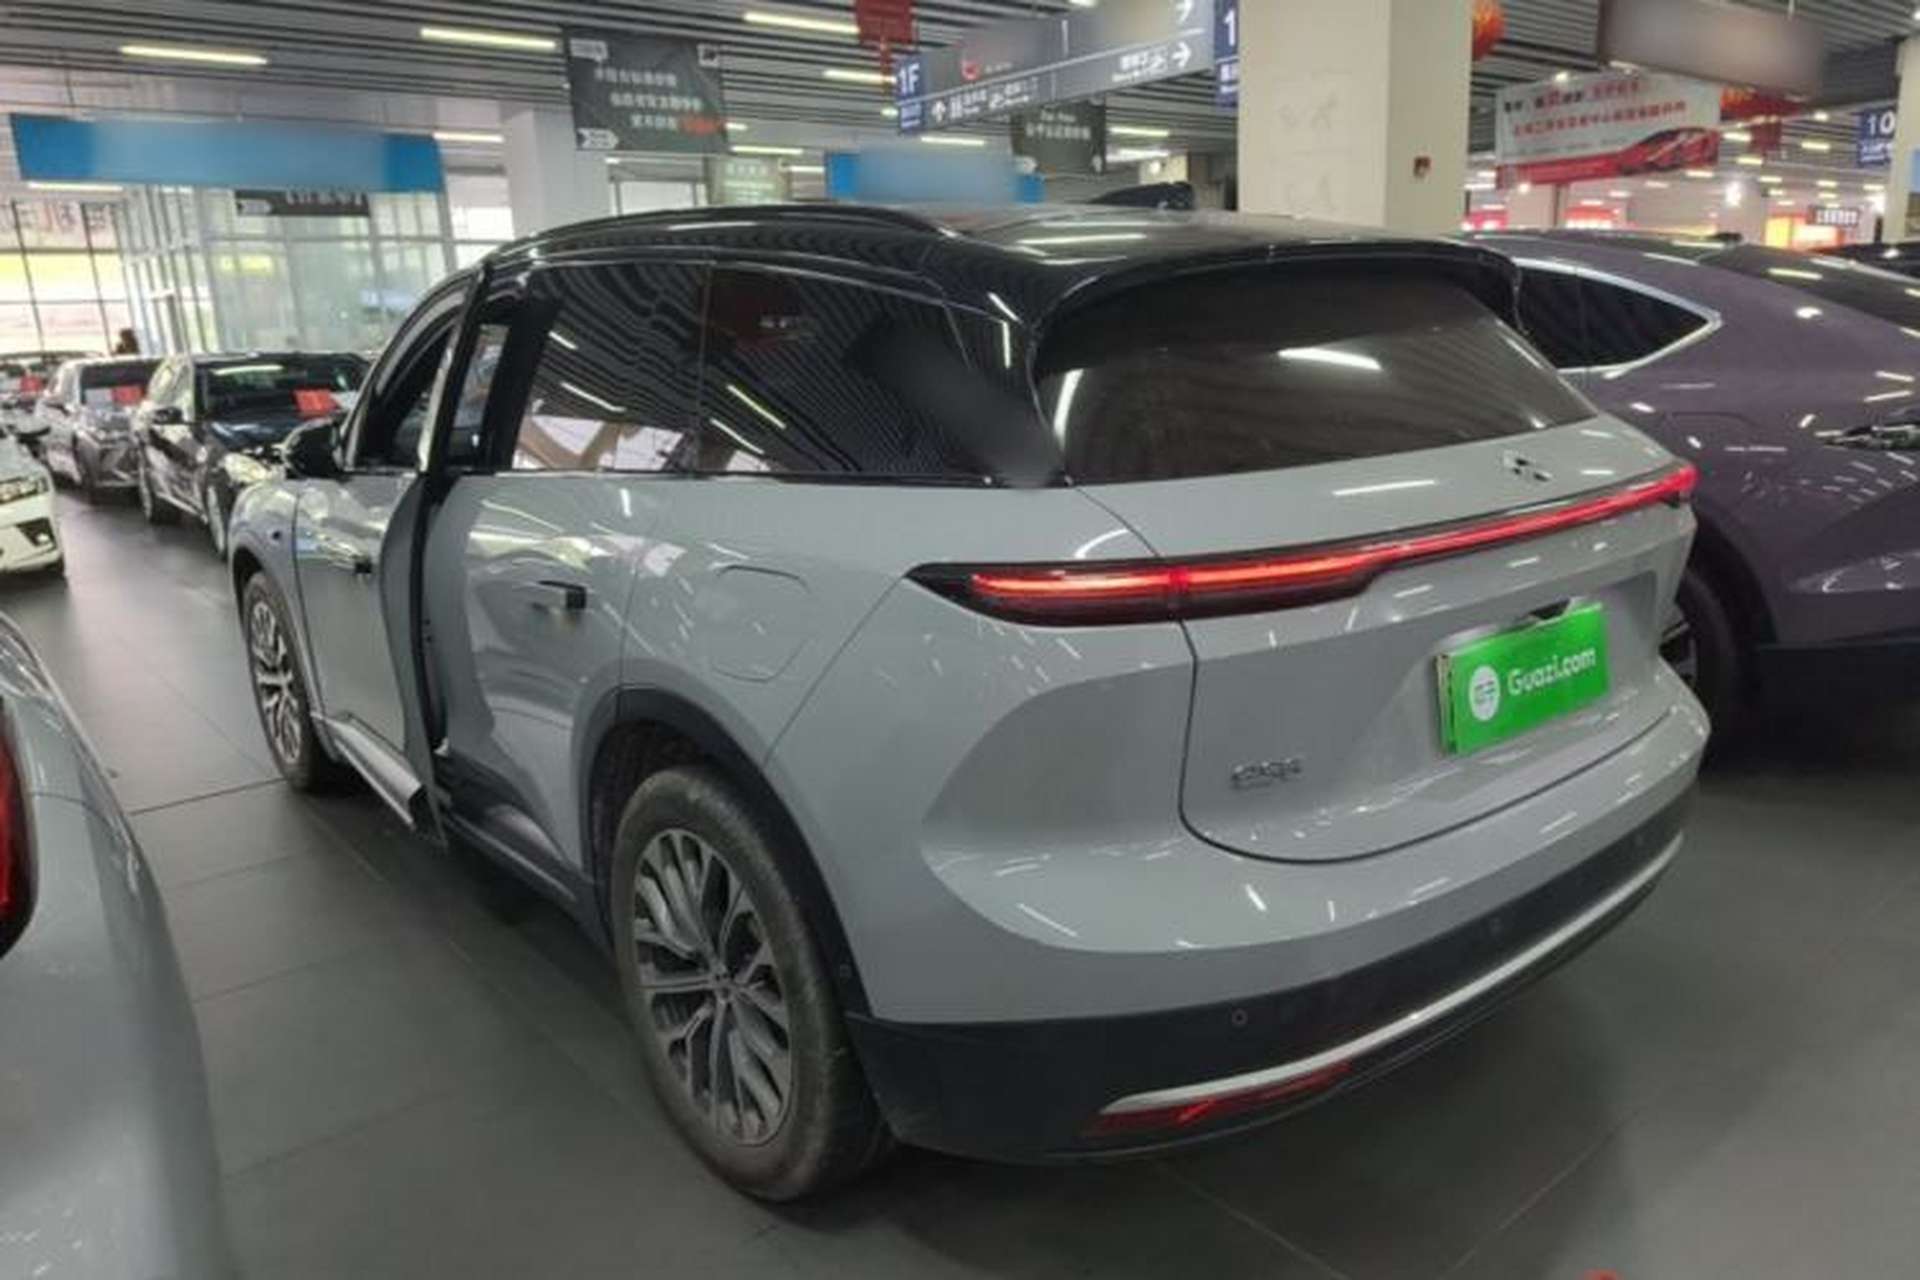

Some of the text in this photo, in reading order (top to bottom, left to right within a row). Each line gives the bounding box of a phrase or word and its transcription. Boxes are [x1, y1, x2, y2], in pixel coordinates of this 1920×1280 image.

[899, 63, 920, 95] 1F
[1867, 111, 1895, 136] 10
[1508, 648, 1596, 696] Guazi.com
